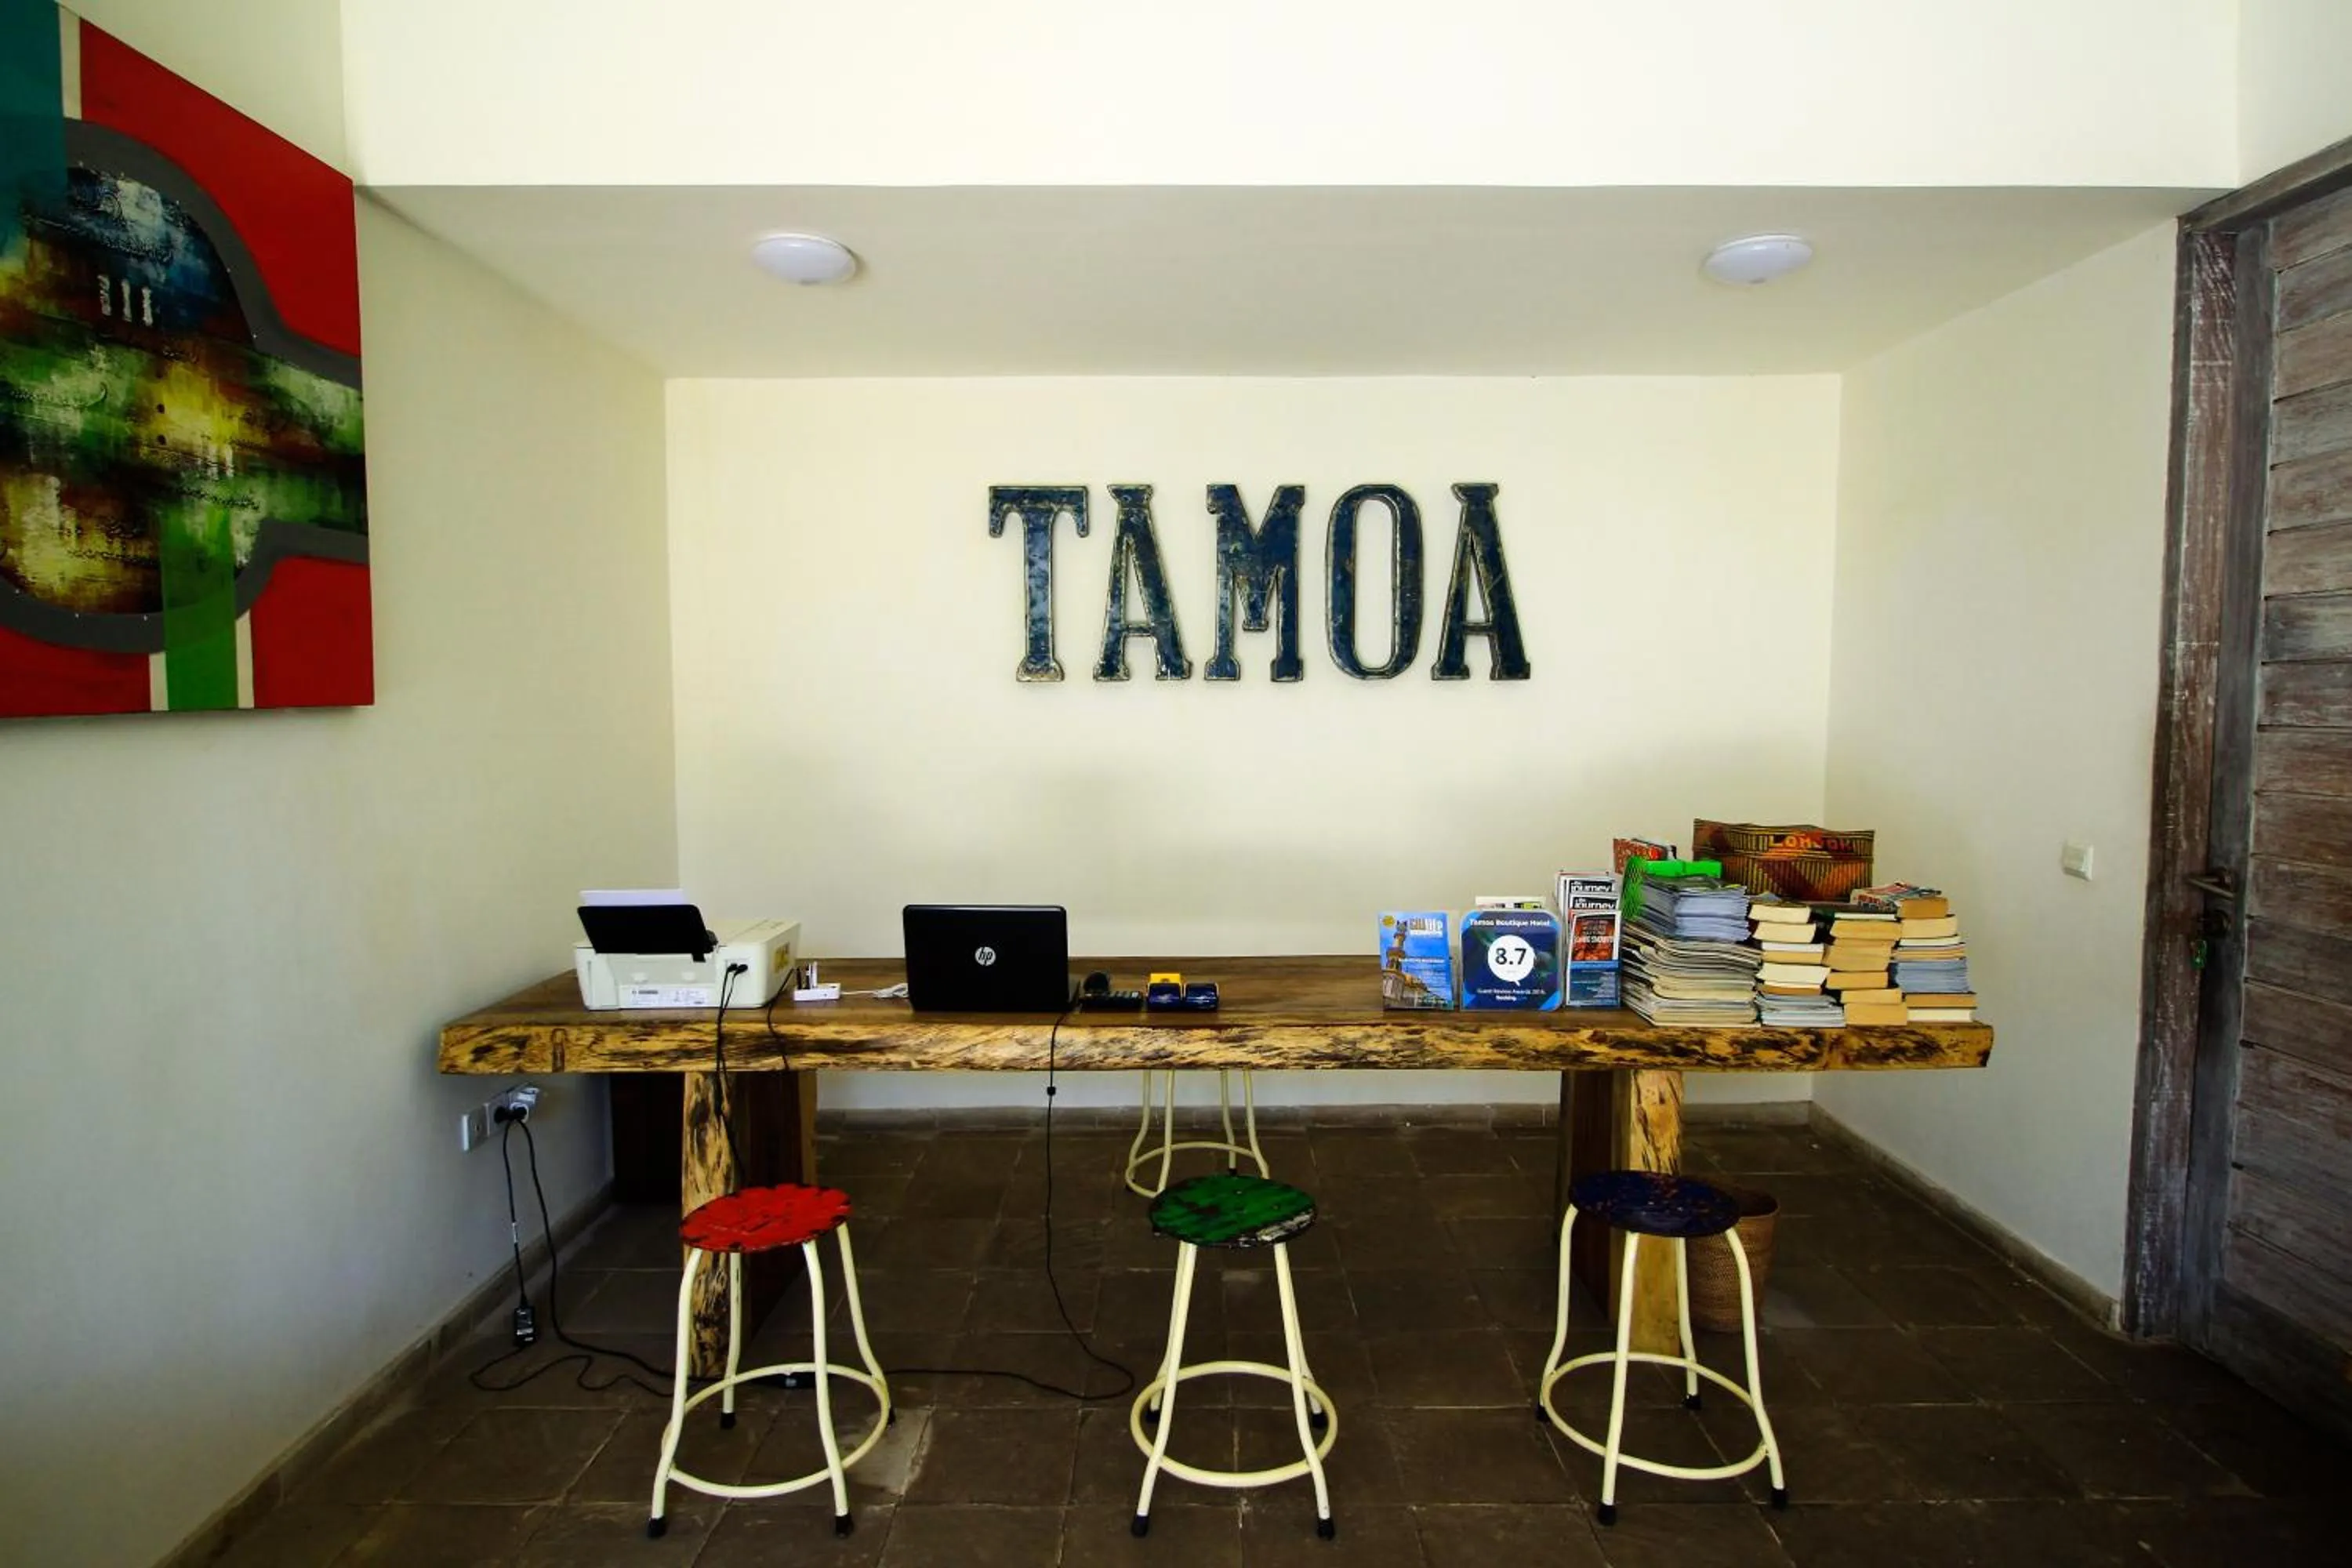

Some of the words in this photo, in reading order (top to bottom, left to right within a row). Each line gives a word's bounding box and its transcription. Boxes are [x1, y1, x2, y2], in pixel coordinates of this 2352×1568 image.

[988, 483, 1531, 682] TAMOA
[1496, 919, 1530, 928] Boutique
[977, 946, 994, 965] hp
[1495, 947, 1527, 965] 8.7
